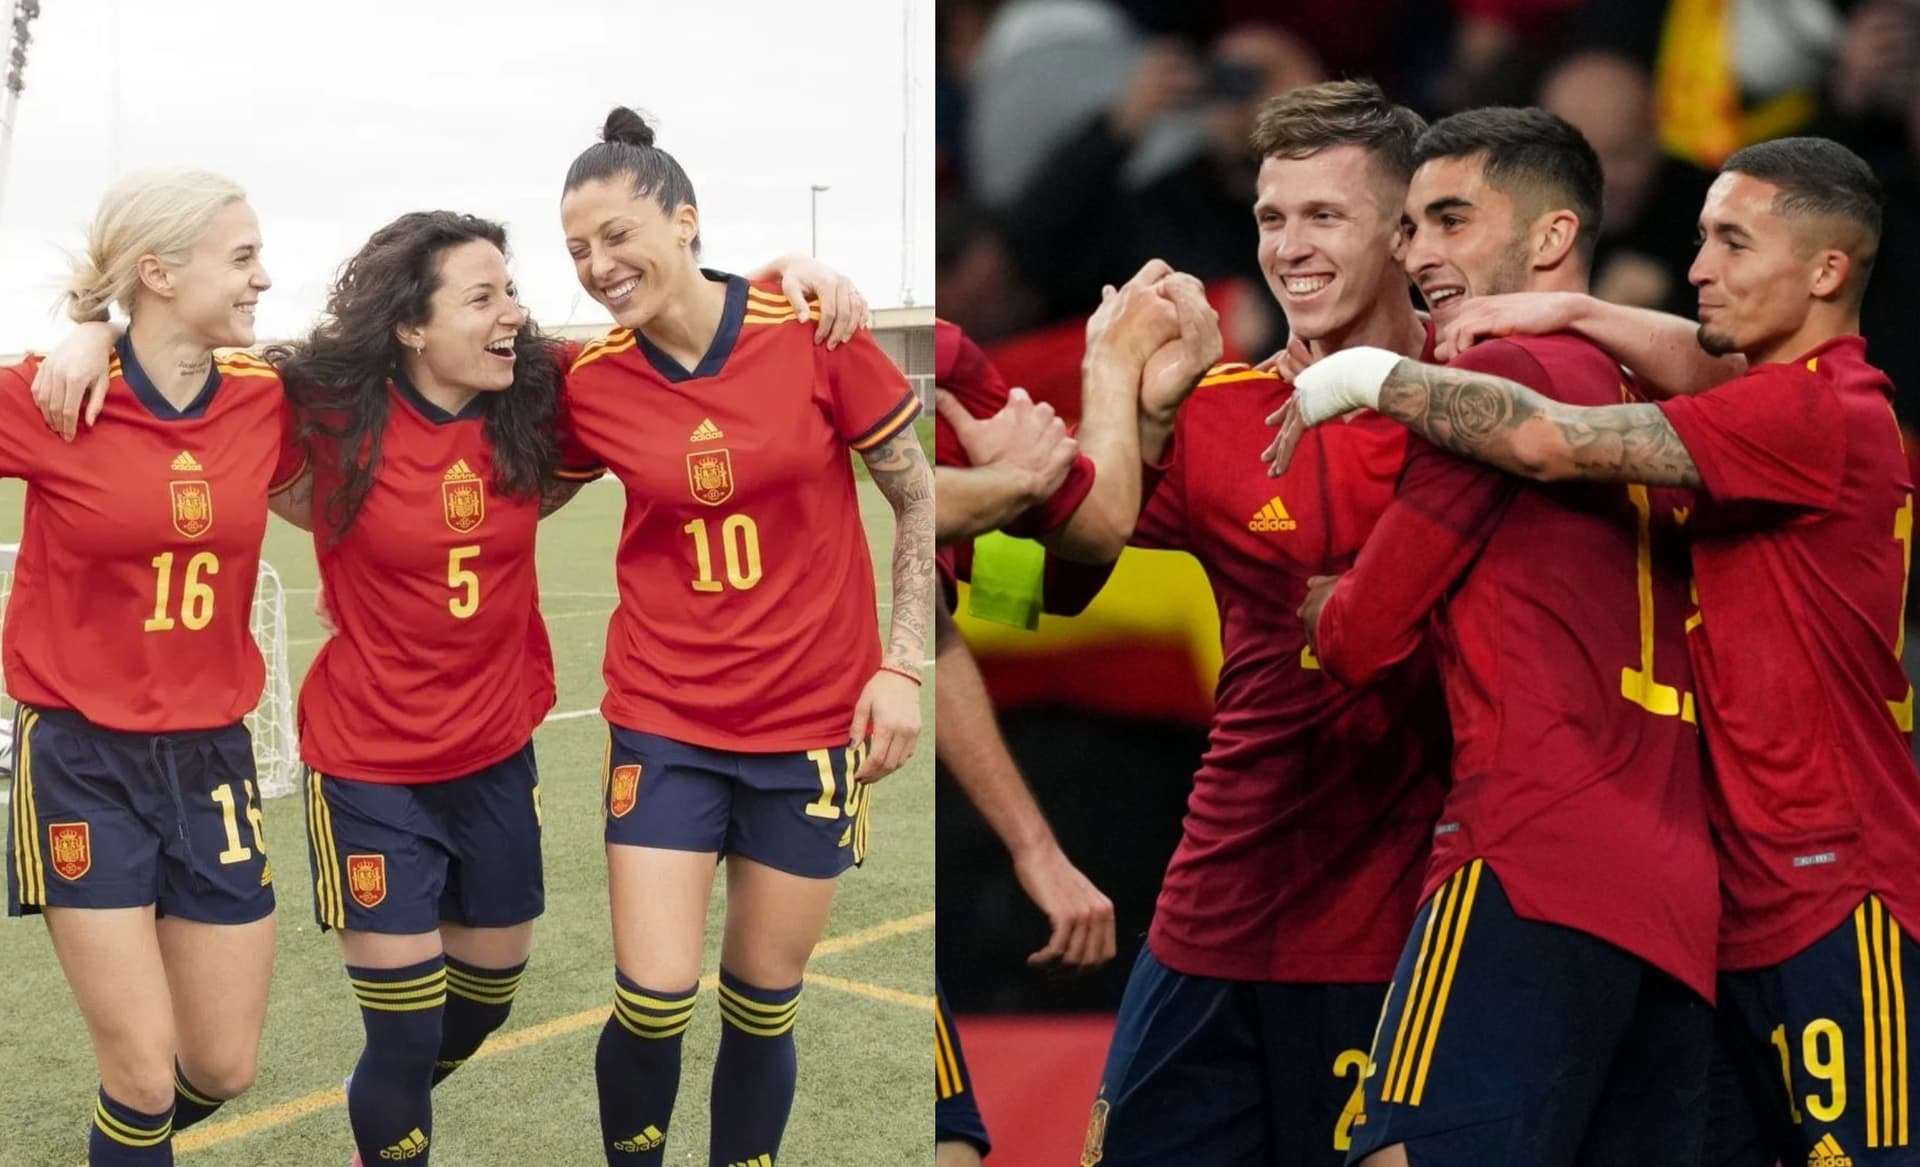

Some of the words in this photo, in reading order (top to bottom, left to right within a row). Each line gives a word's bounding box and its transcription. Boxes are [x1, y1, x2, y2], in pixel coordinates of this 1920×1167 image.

[690, 431, 724, 442] adidas
[170, 463, 203, 471] adidas
[1248, 518, 1296, 531] adidas
[684, 514, 762, 592] 10
[144, 551, 219, 632] 16
[448, 545, 480, 618] 5
[1771, 1018, 1847, 1124] 19
[380, 1136, 429, 1160] adidas
[614, 1132, 666, 1152] adidas
